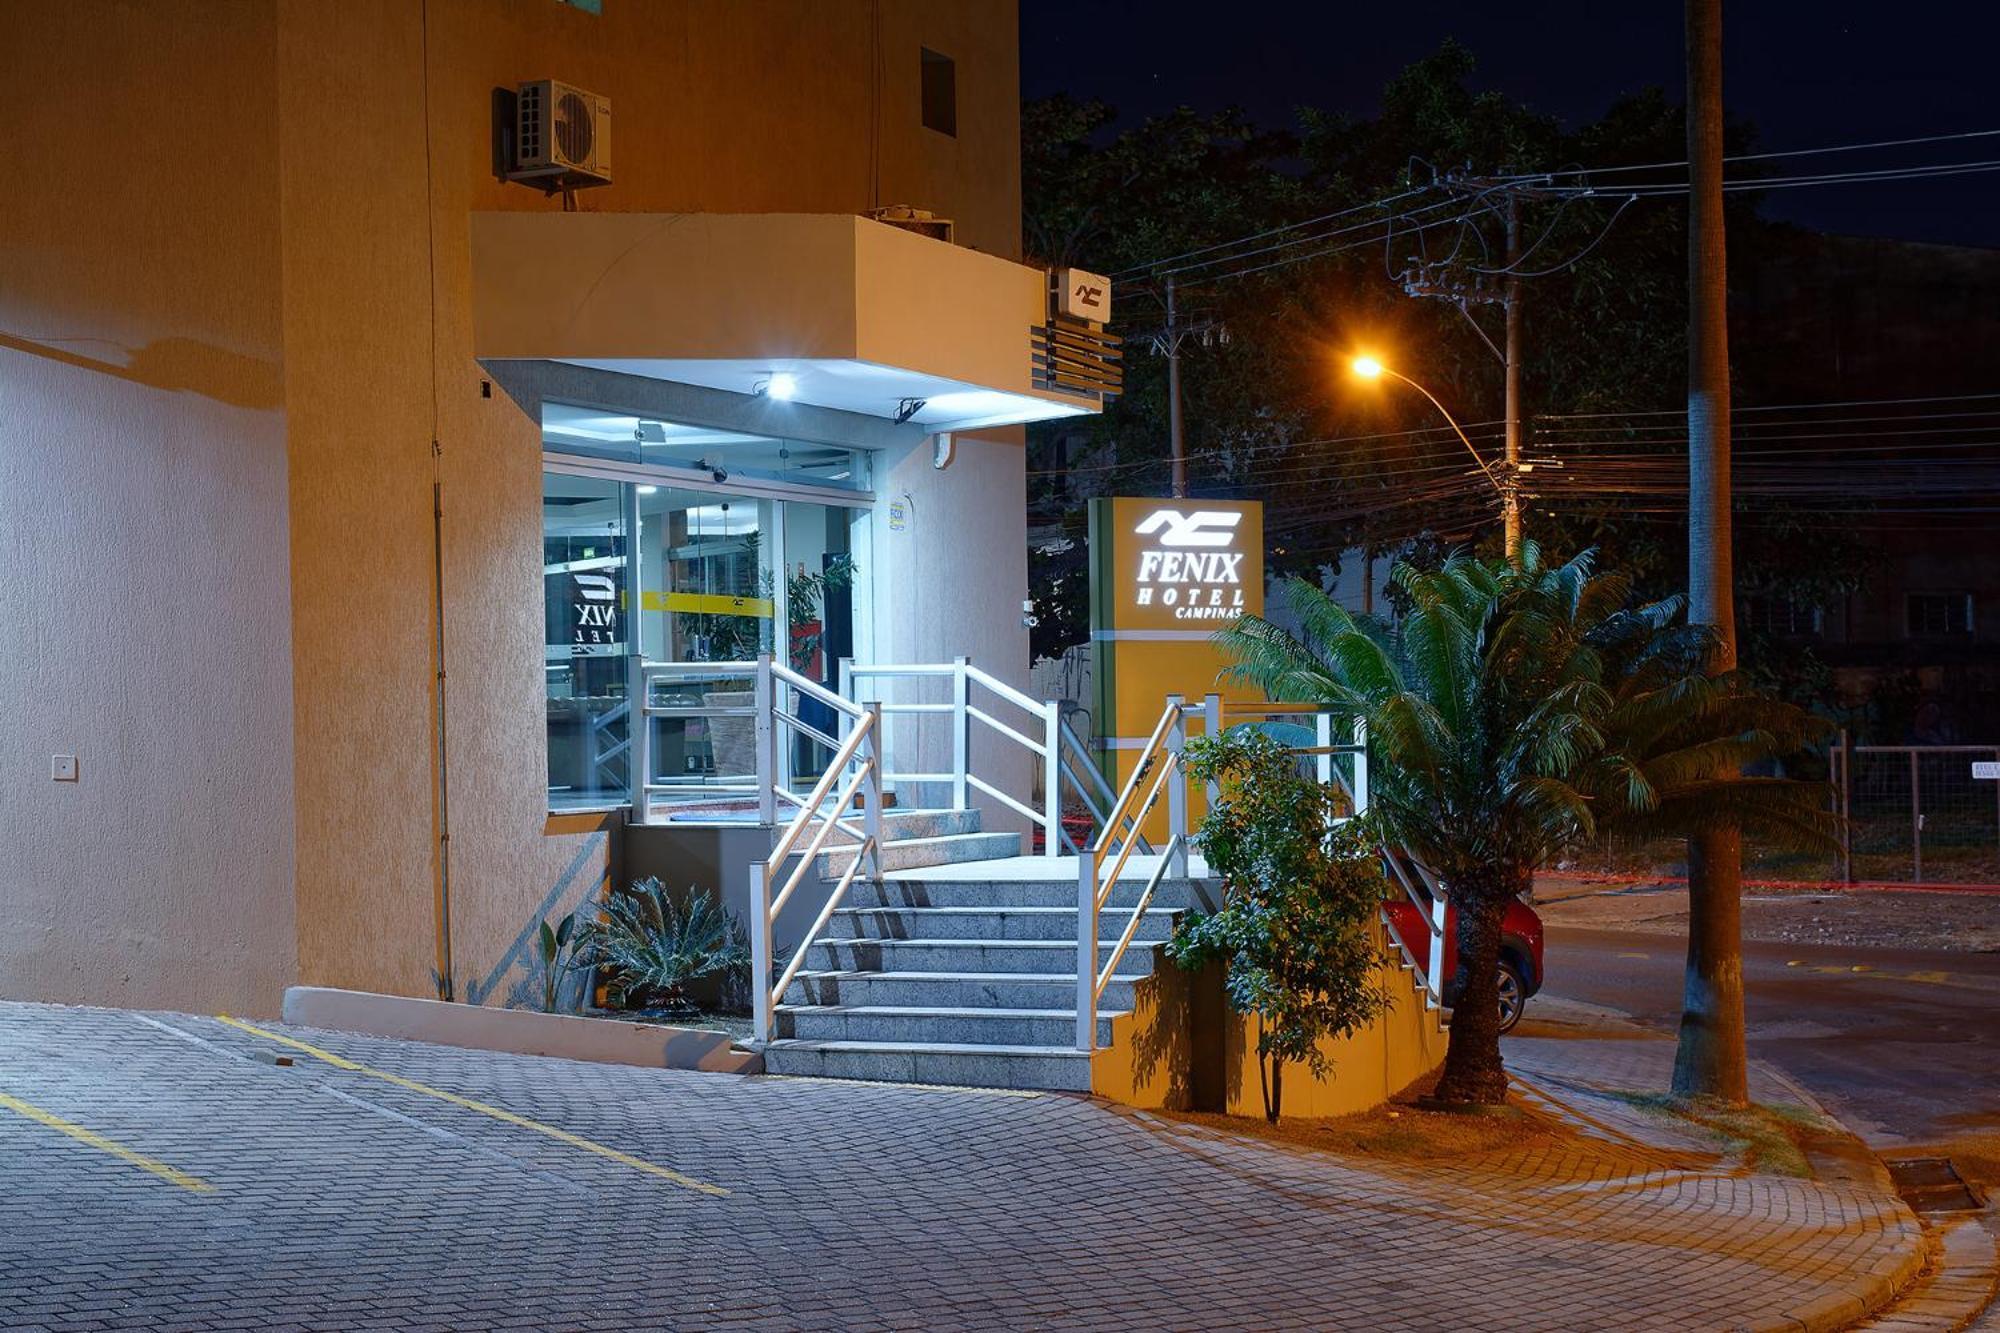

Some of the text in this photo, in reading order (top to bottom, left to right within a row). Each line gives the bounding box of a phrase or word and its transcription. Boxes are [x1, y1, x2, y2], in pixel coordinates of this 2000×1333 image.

[1136, 551, 1243, 583] FENIX
[1136, 588, 1244, 606] HOTEL
[1175, 607, 1243, 619] CAMPINAS
